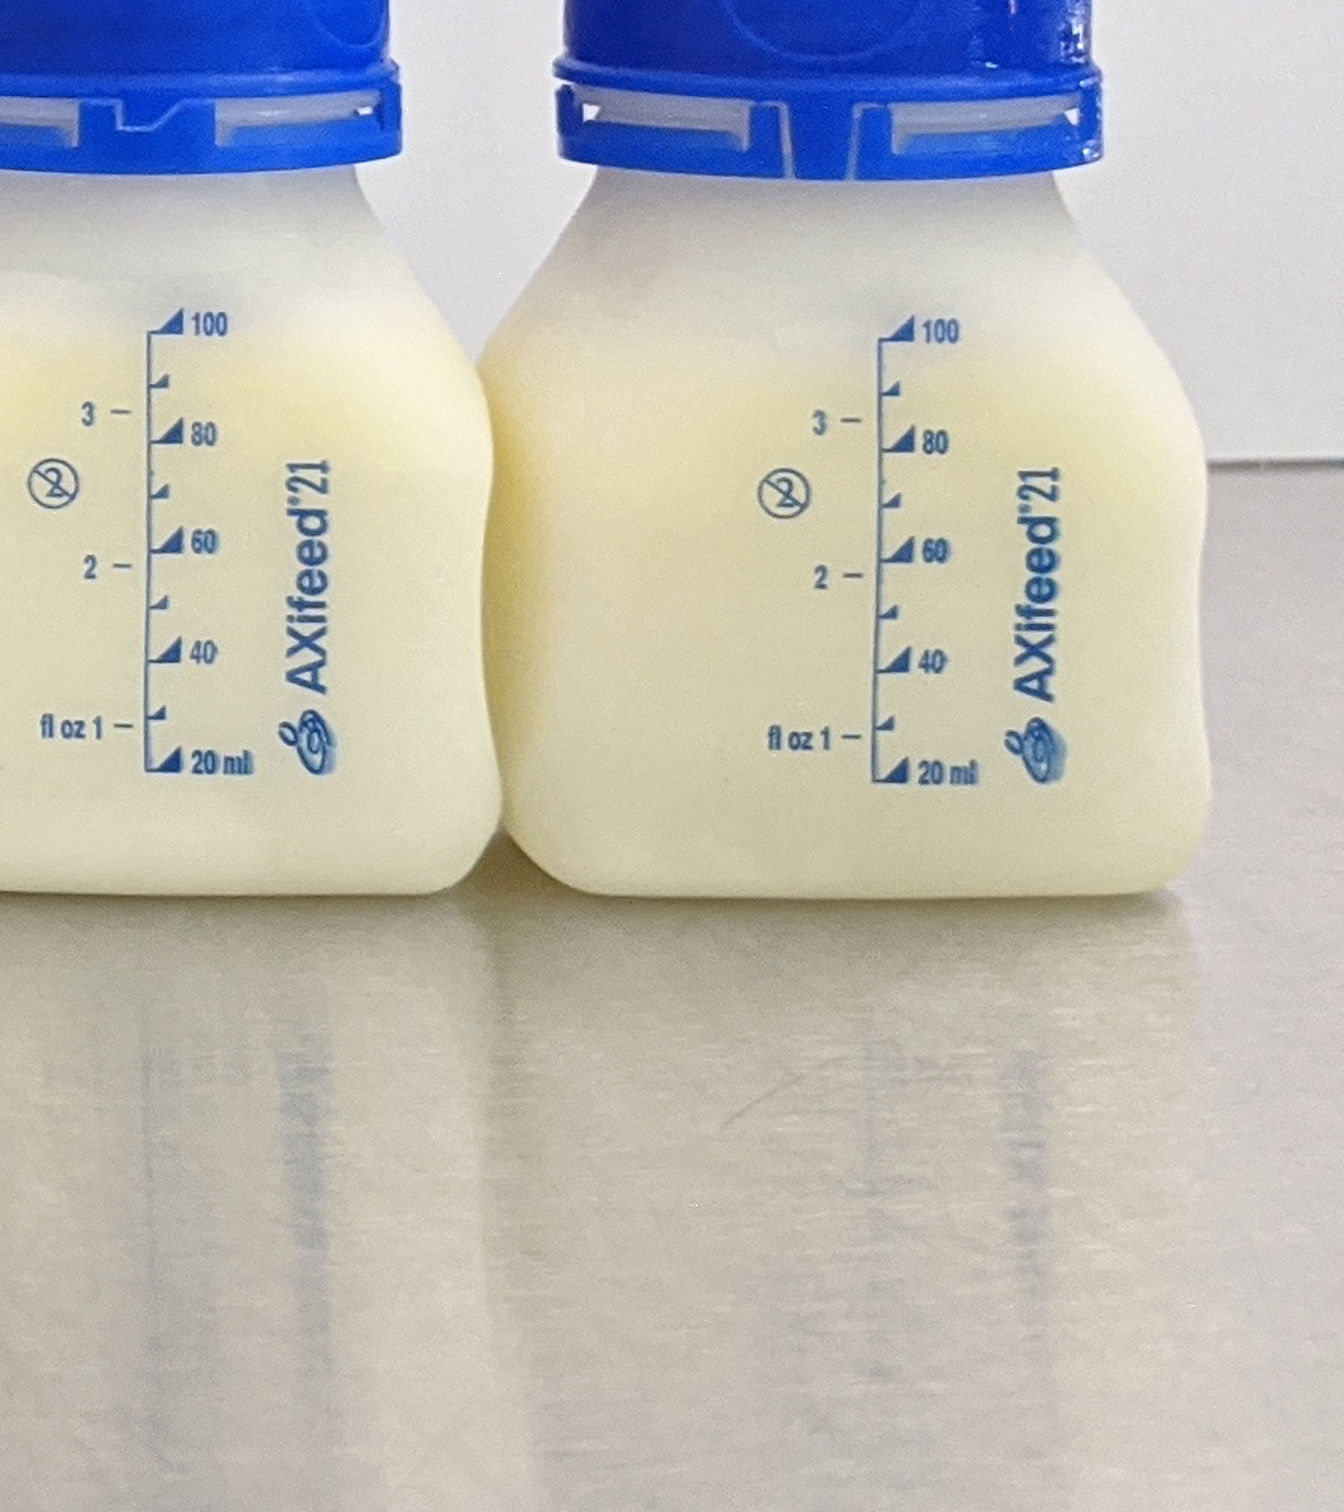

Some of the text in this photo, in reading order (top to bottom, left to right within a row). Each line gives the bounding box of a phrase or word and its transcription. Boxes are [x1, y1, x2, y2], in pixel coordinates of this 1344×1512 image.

[190, 310, 229, 337] 100
[921, 317, 961, 345] 100
[81, 400, 97, 428] 3
[812, 409, 828, 436] 3
[190, 420, 219, 448] 80
[921, 428, 950, 456] 80
[190, 528, 219, 555] 60
[921, 536, 950, 565] 60
[83, 554, 98, 581] 2
[813, 564, 829, 591] 2
[189, 639, 217, 665] 40
[917, 648, 948, 675] 40
[59, 719, 87, 740] oz
[92, 715, 103, 741] 1
[787, 730, 814, 752] oz
[819, 725, 831, 751] 1
[190, 748, 253, 777] 20 ml
[917, 758, 978, 786] 20 ml
